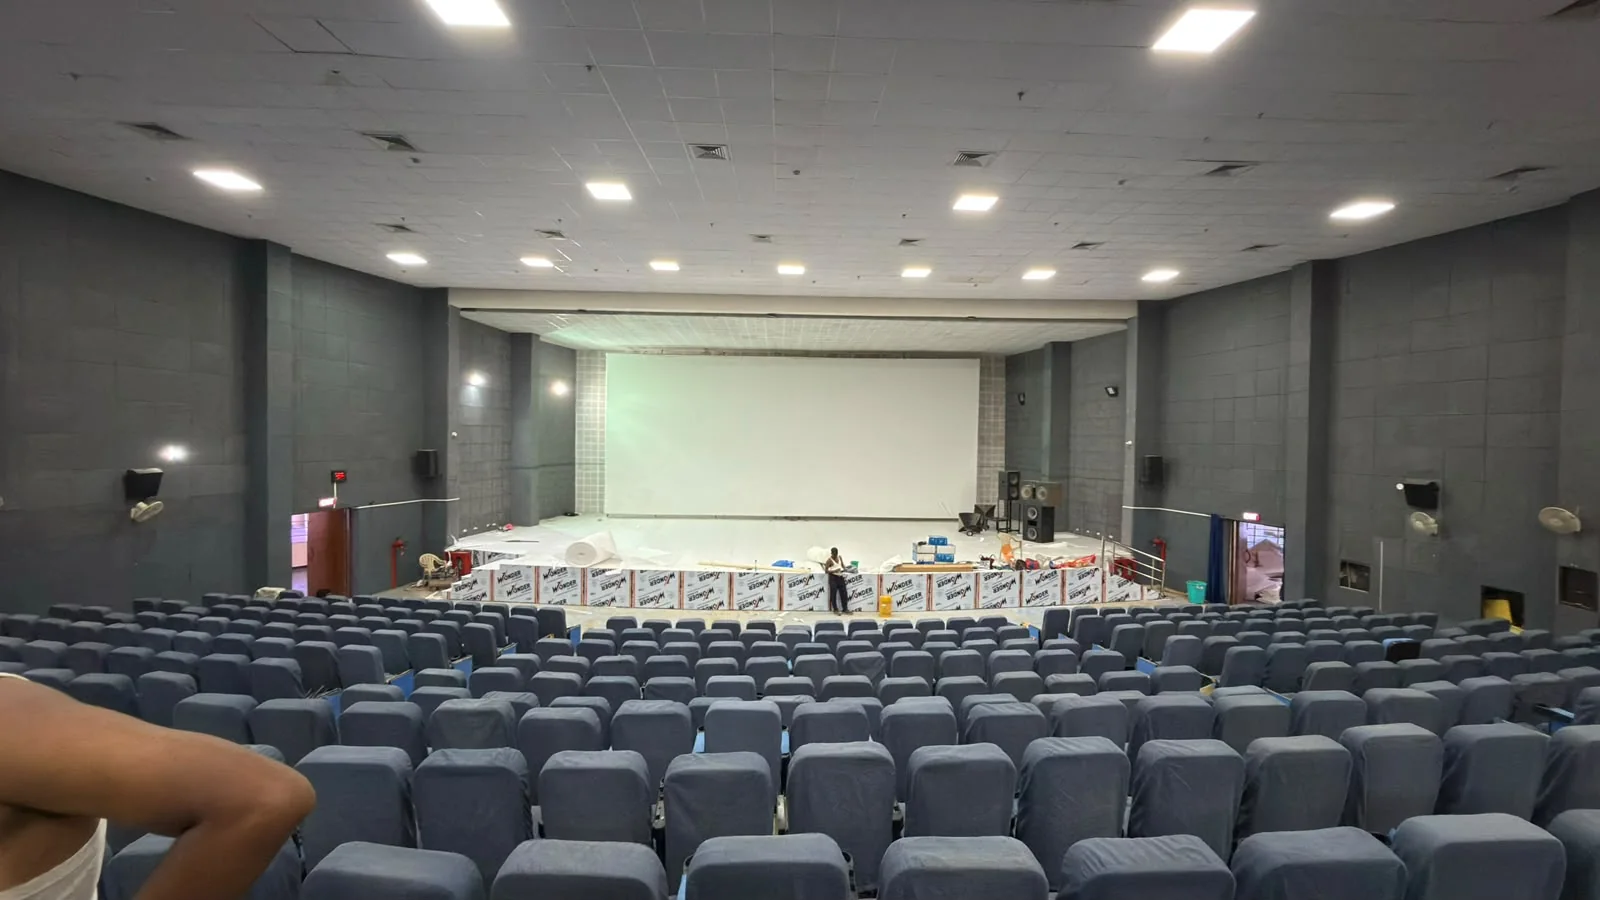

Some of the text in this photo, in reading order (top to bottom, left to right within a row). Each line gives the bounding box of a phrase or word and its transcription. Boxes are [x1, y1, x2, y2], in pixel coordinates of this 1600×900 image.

[497, 570, 521, 584] WONDER
[601, 577, 626, 591] WONDER
[650, 572, 675, 587] WONDER
[748, 576, 775, 591] WONDER
[788, 574, 815, 588] WONDER
[844, 575, 863, 586] ONDER
[937, 573, 962, 588] WONDER
[1035, 570, 1057, 585] WONDER
[506, 583, 531, 597] WONDER
[552, 579, 576, 593] WONDER
[886, 579, 913, 594] WONDER
[946, 585, 972, 600] WONDER
[993, 577, 1017, 593] WONDER
[640, 592, 665, 606] WONDER
[688, 586, 714, 602] WONDER
[798, 587, 825, 602] WONDER
[896, 592, 922, 607] WONDER
[1026, 589, 1049, 604] WONDER
[738, 596, 764, 610] WONDER
